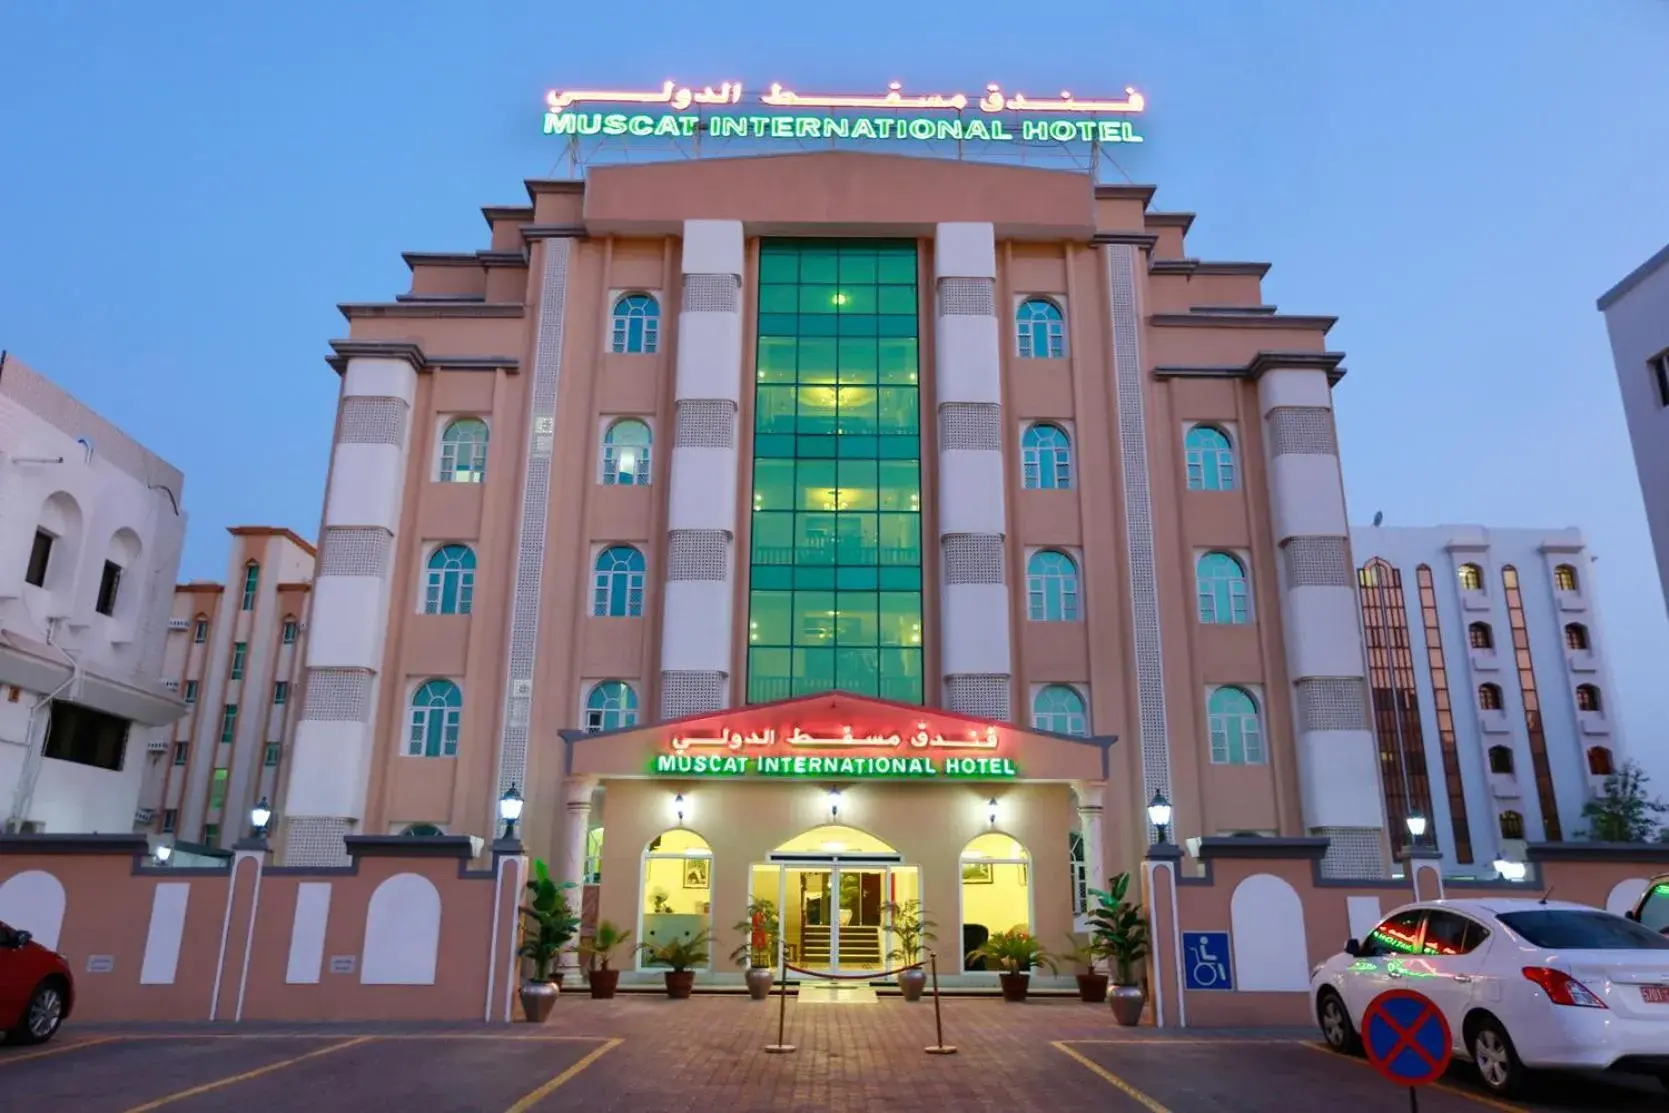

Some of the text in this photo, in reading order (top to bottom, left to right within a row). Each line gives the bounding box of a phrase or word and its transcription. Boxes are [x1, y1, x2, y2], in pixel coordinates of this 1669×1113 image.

[546, 80, 1144, 113] فندق مسقط الدولي
[543, 112, 1143, 142] MUSCAT INTERNATIONAL HOTEL
[672, 721, 998, 755] فندق مسقط الدولي
[658, 755, 1015, 775] MUSCAT INTERNATIONAL HOTEL
